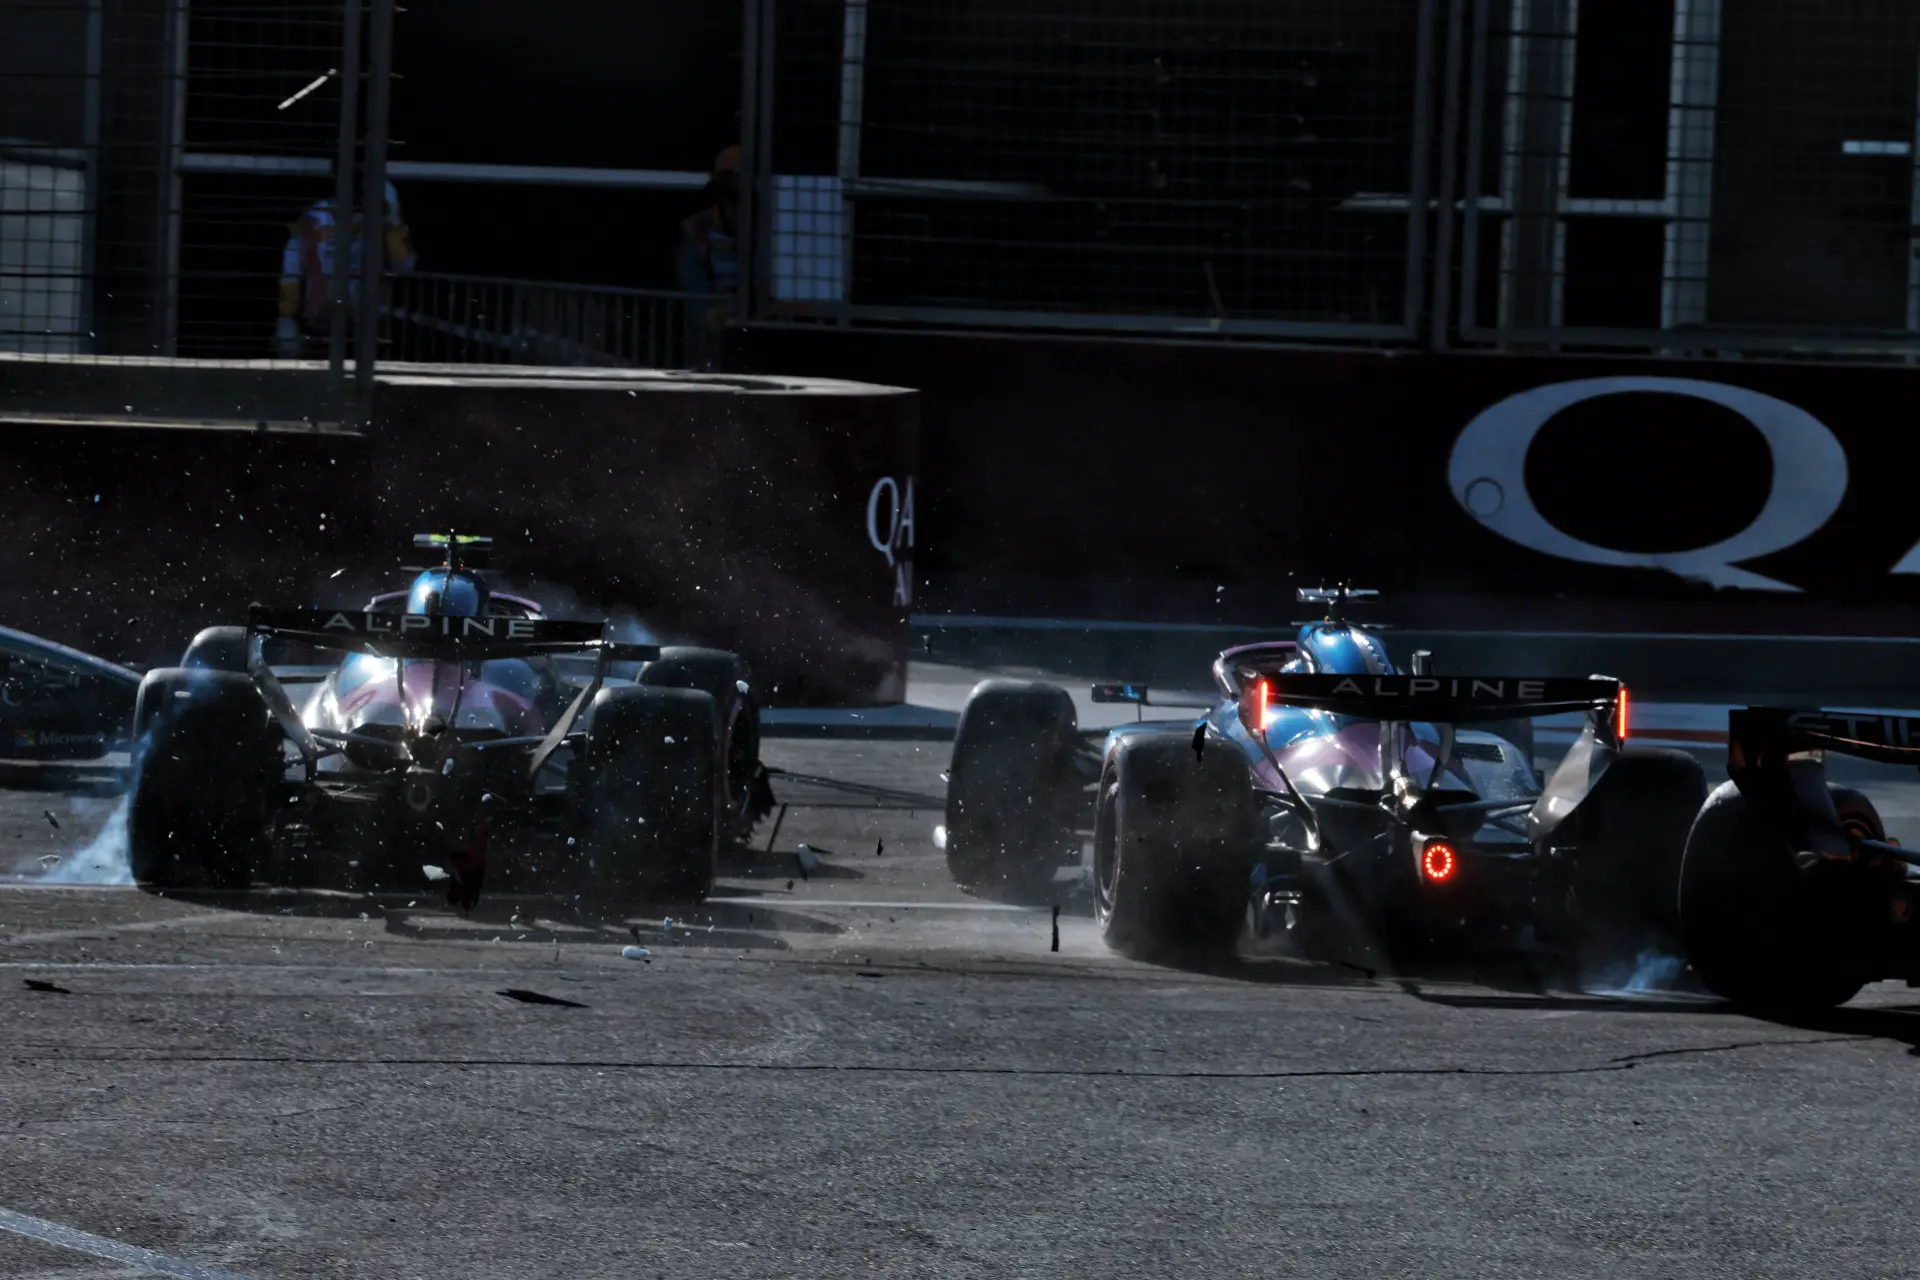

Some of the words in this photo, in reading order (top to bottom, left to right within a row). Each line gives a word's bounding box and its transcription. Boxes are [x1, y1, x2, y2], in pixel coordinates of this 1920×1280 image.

[1446, 374, 1920, 593] Q
[321, 611, 536, 639] ALPINE
[1328, 676, 1547, 699] ALPINE
